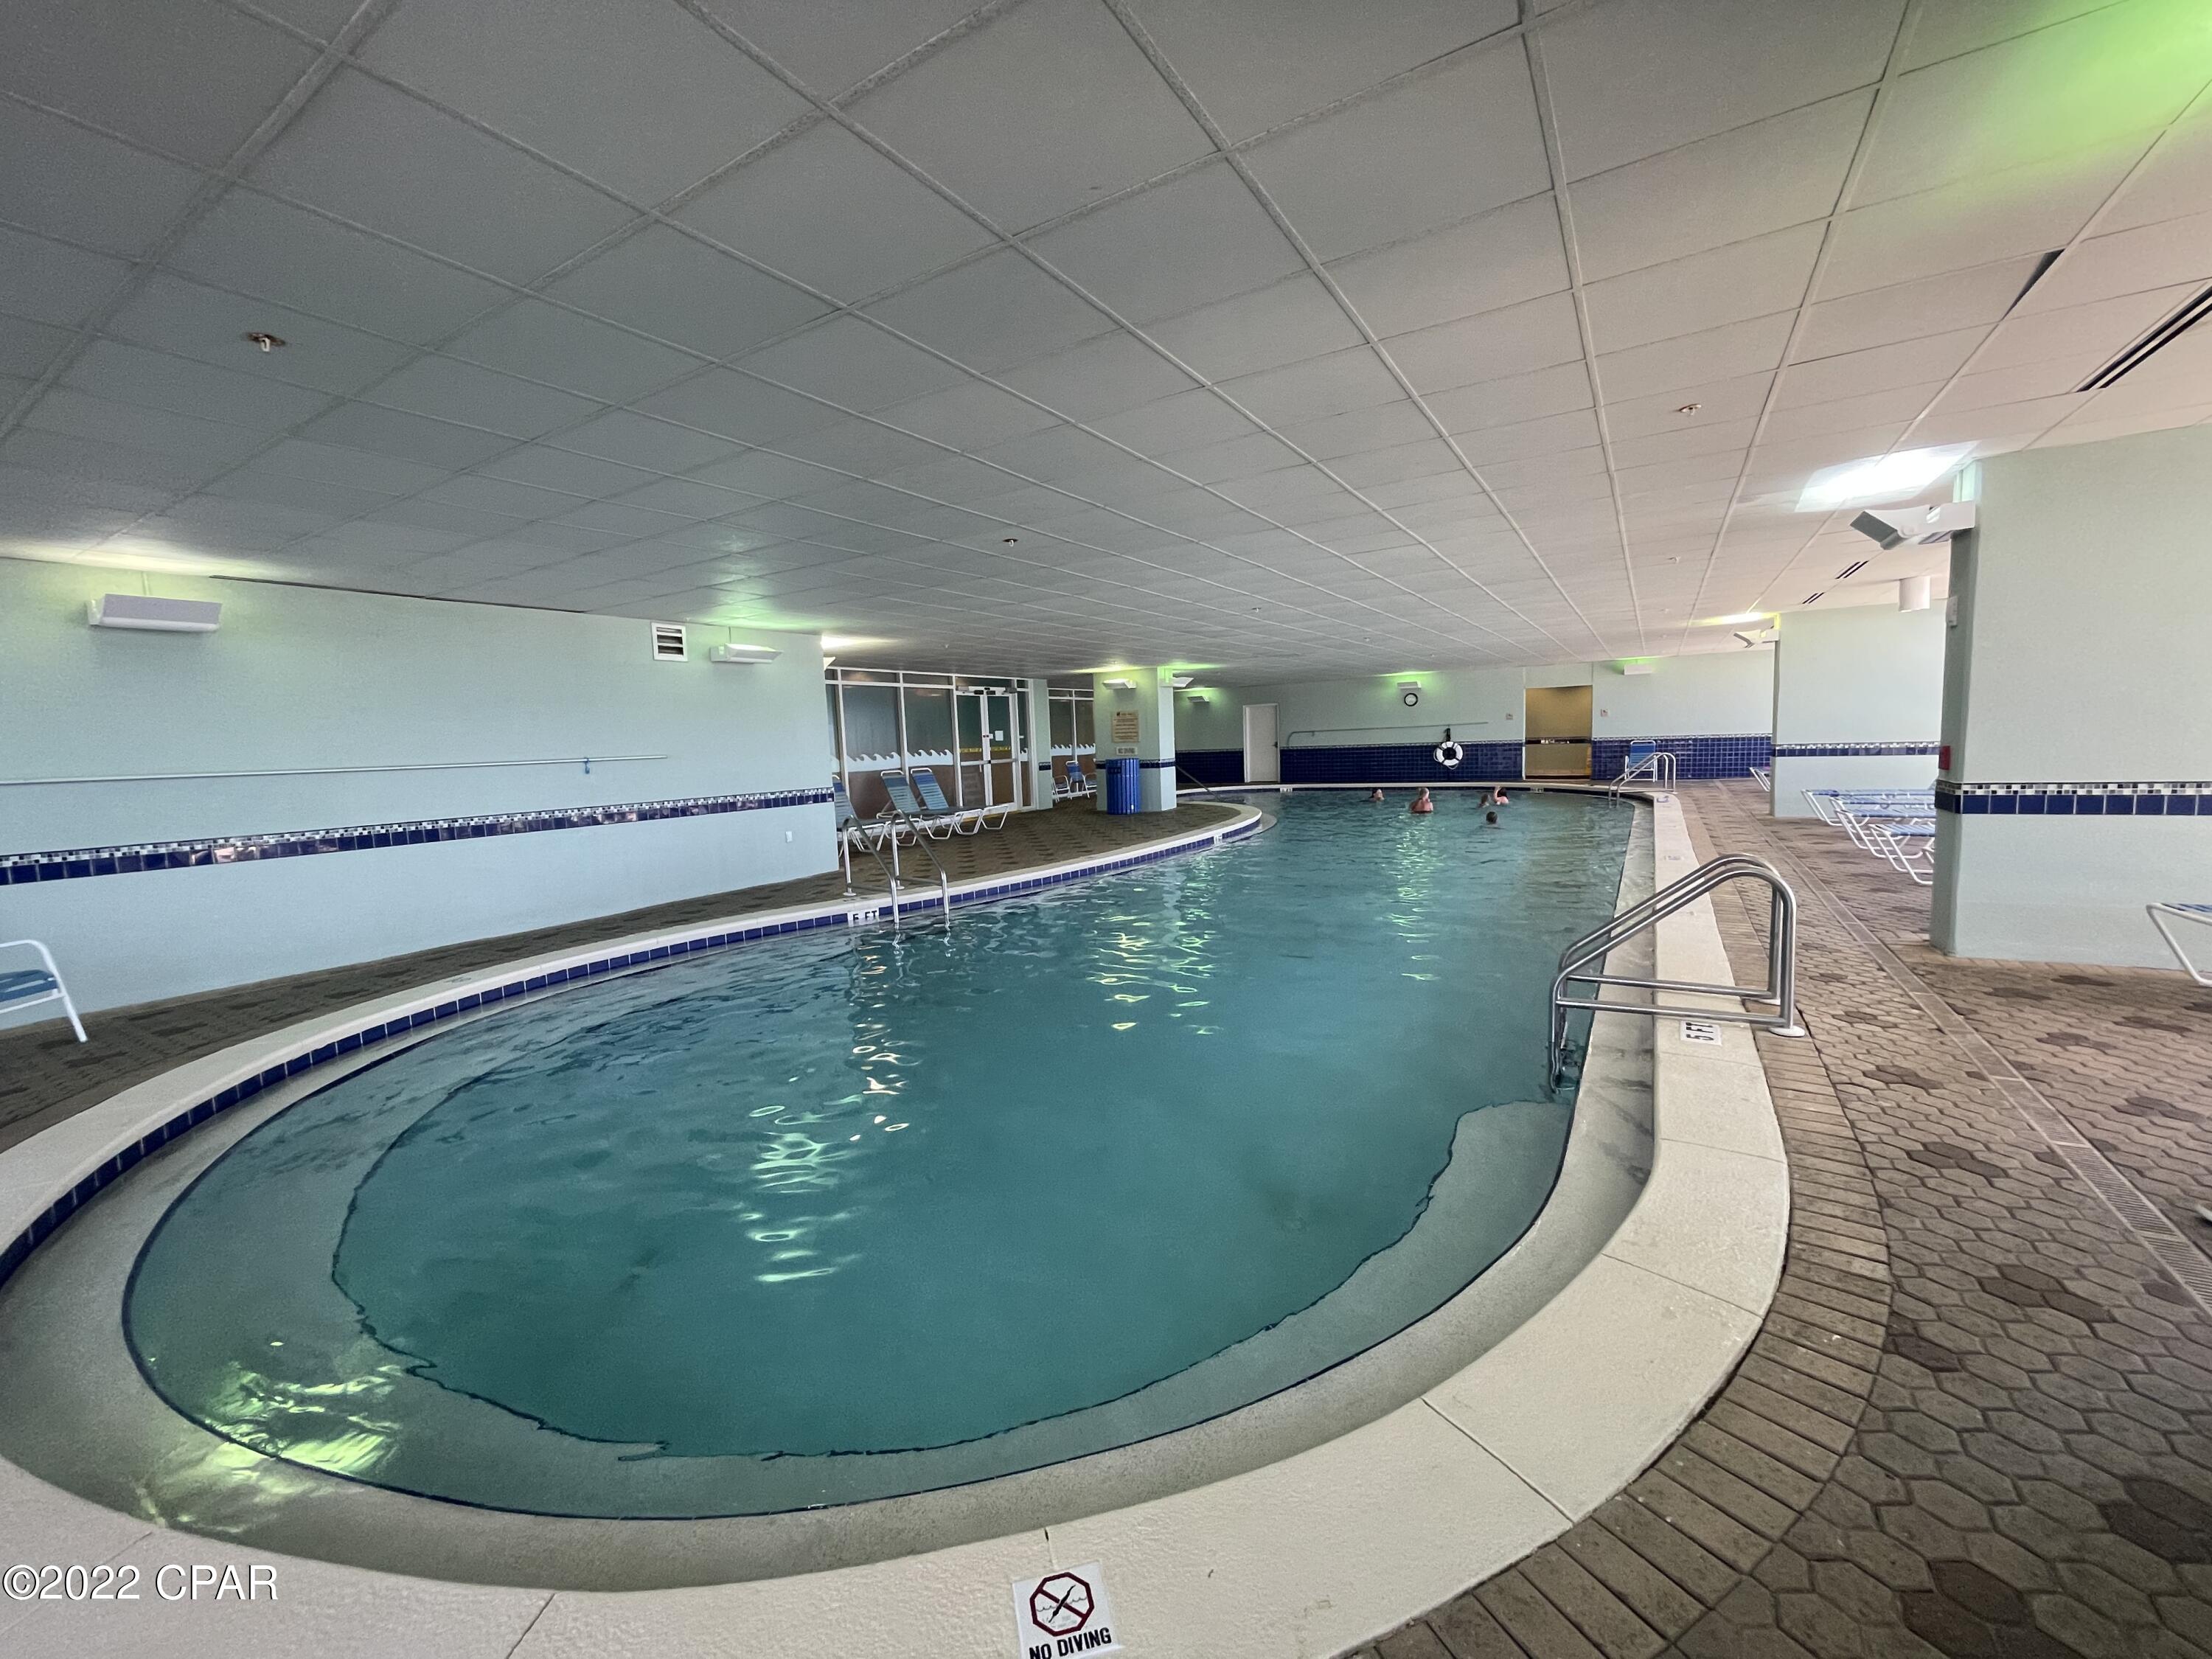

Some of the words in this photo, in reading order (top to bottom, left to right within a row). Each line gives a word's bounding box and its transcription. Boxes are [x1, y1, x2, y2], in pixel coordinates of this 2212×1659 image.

[865, 910, 877, 920] FT
[1686, 1022, 1714, 1034] FT
[1029, 1643, 1052, 1659] NO
[1057, 1627, 1112, 1657] DIVING
